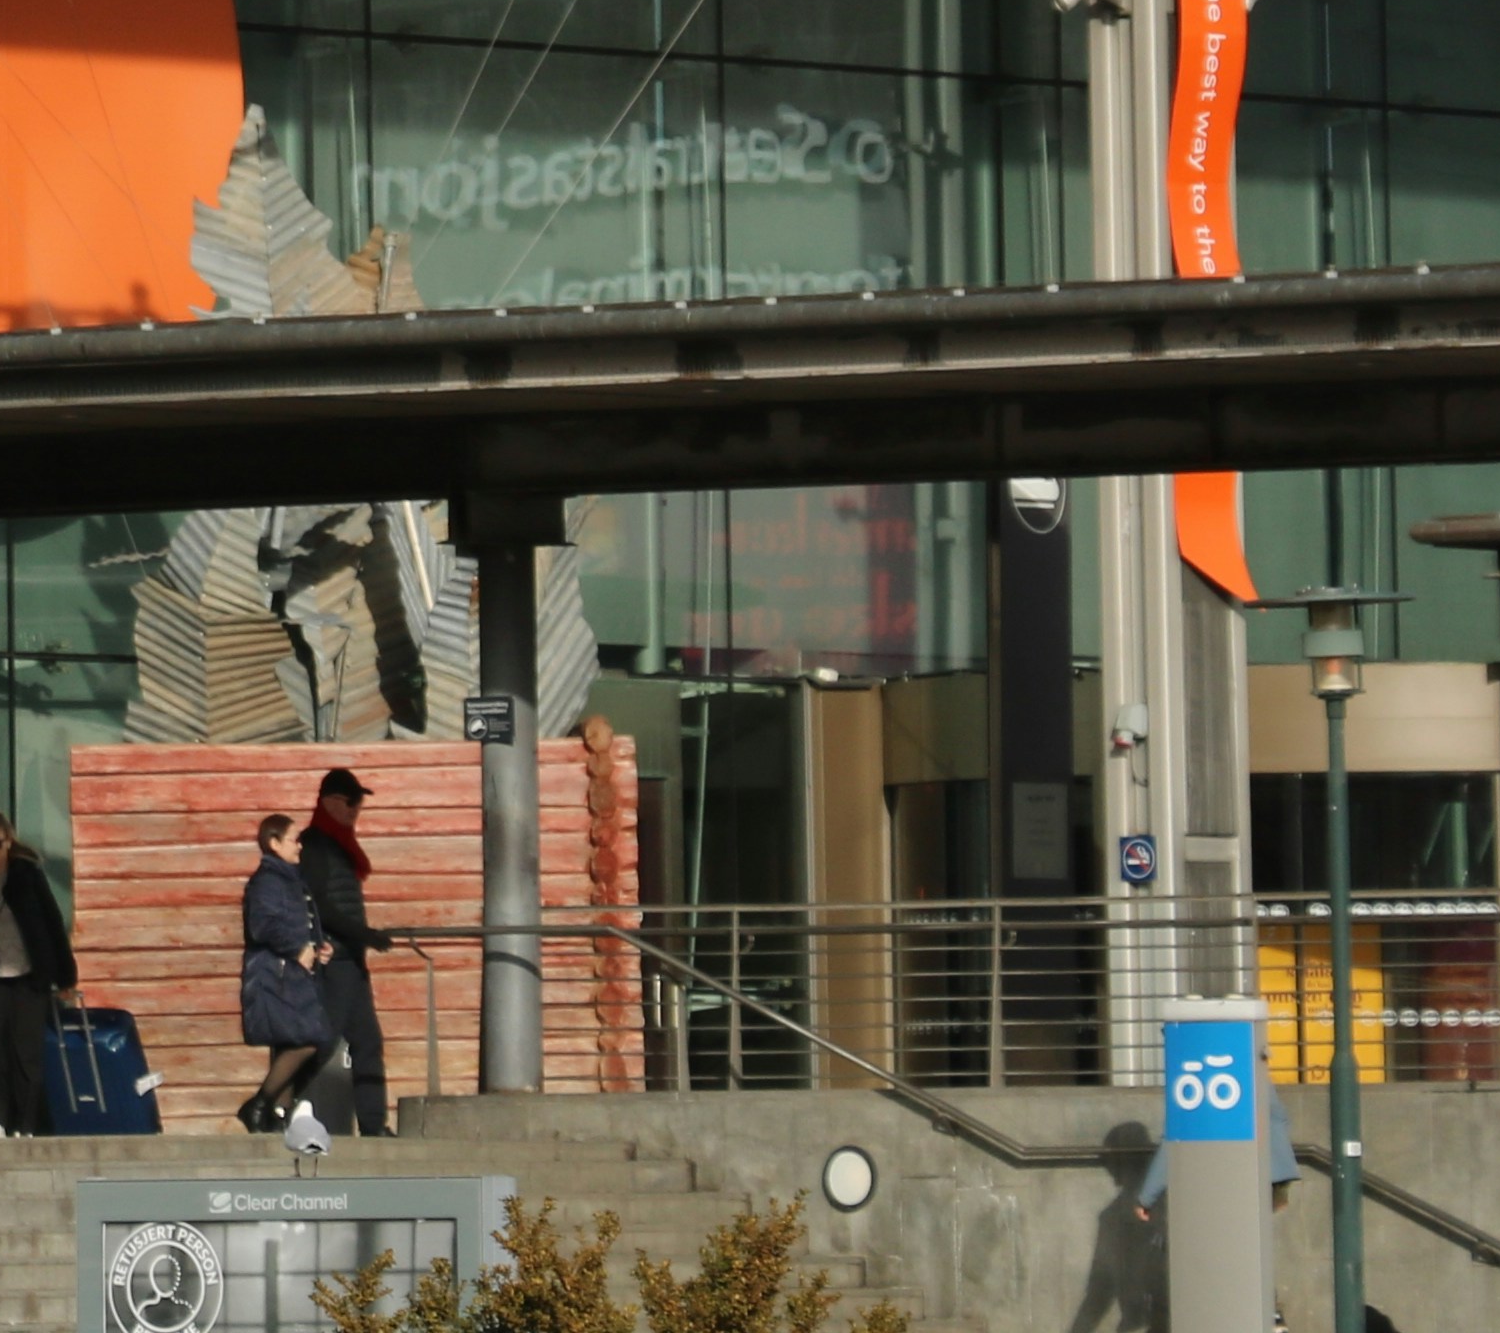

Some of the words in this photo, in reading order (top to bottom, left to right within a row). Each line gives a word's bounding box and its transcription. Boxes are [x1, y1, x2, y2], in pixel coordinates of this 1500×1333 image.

[1201, 33, 1226, 101] best
[1189, 111, 1211, 172] way
[1192, 182, 1207, 214] to
[1196, 225, 1216, 275] the
[234, 1194, 279, 1211] Clear
[281, 1193, 348, 1211] Channel
[113, 1225, 176, 1287] RETUSJERT
[177, 1228, 219, 1286] PERSON
